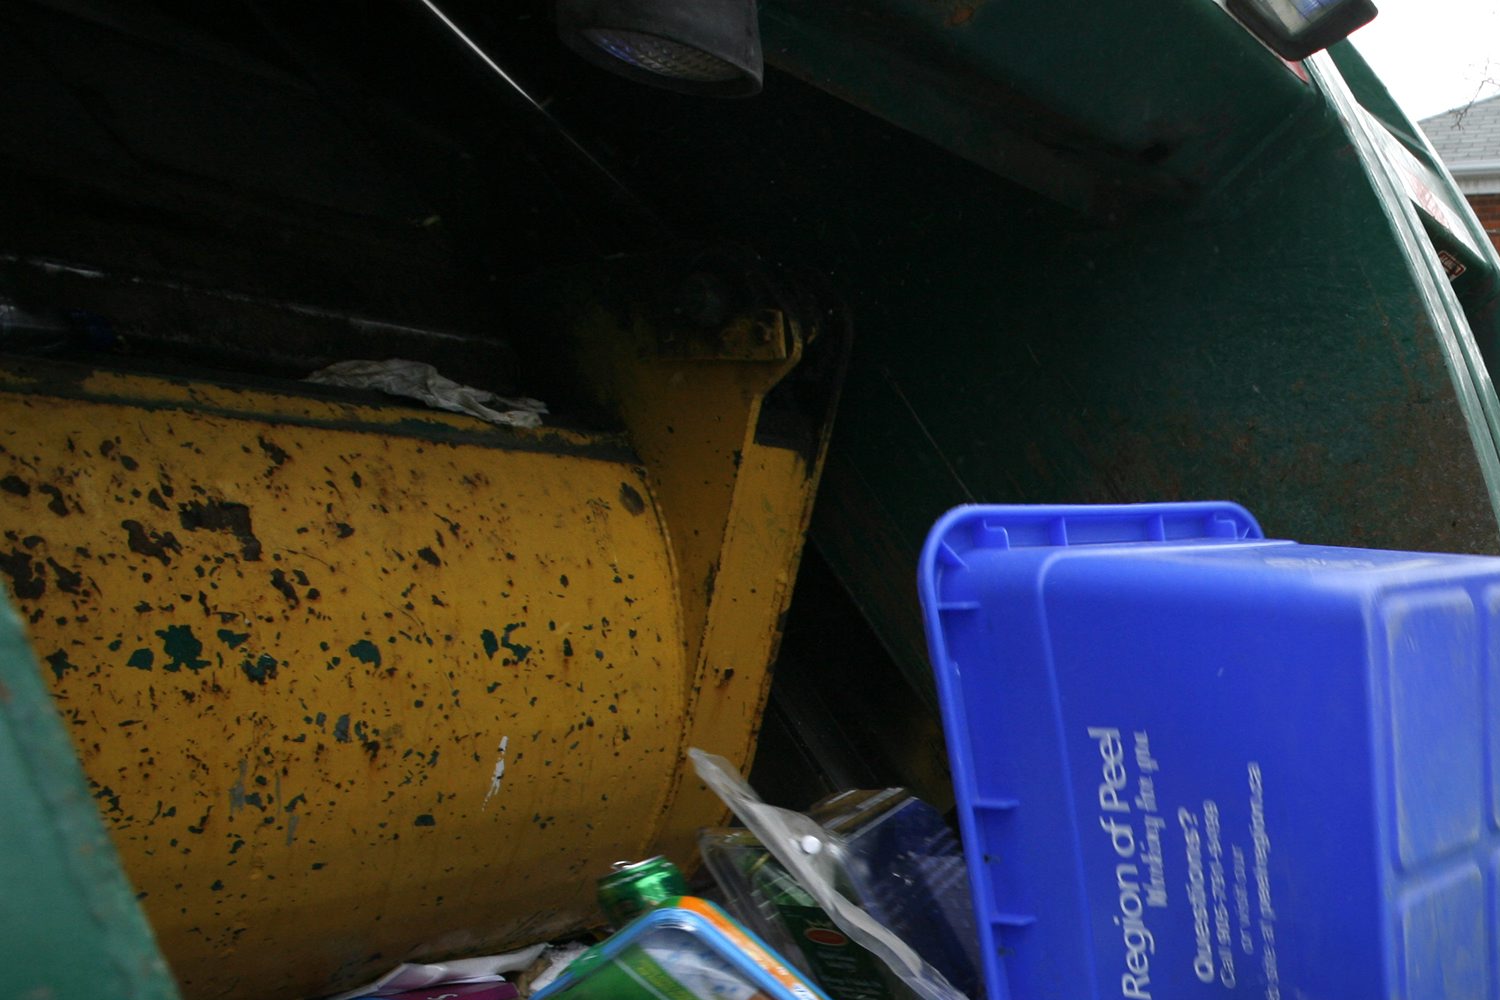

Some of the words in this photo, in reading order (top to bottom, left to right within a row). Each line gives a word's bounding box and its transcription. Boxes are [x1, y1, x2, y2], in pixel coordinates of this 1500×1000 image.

[1087, 727, 1131, 813] Peel
[1100, 816, 1135, 857] of
[1112, 863, 1155, 1000] Region
[1178, 805, 1215, 983] Questions?
